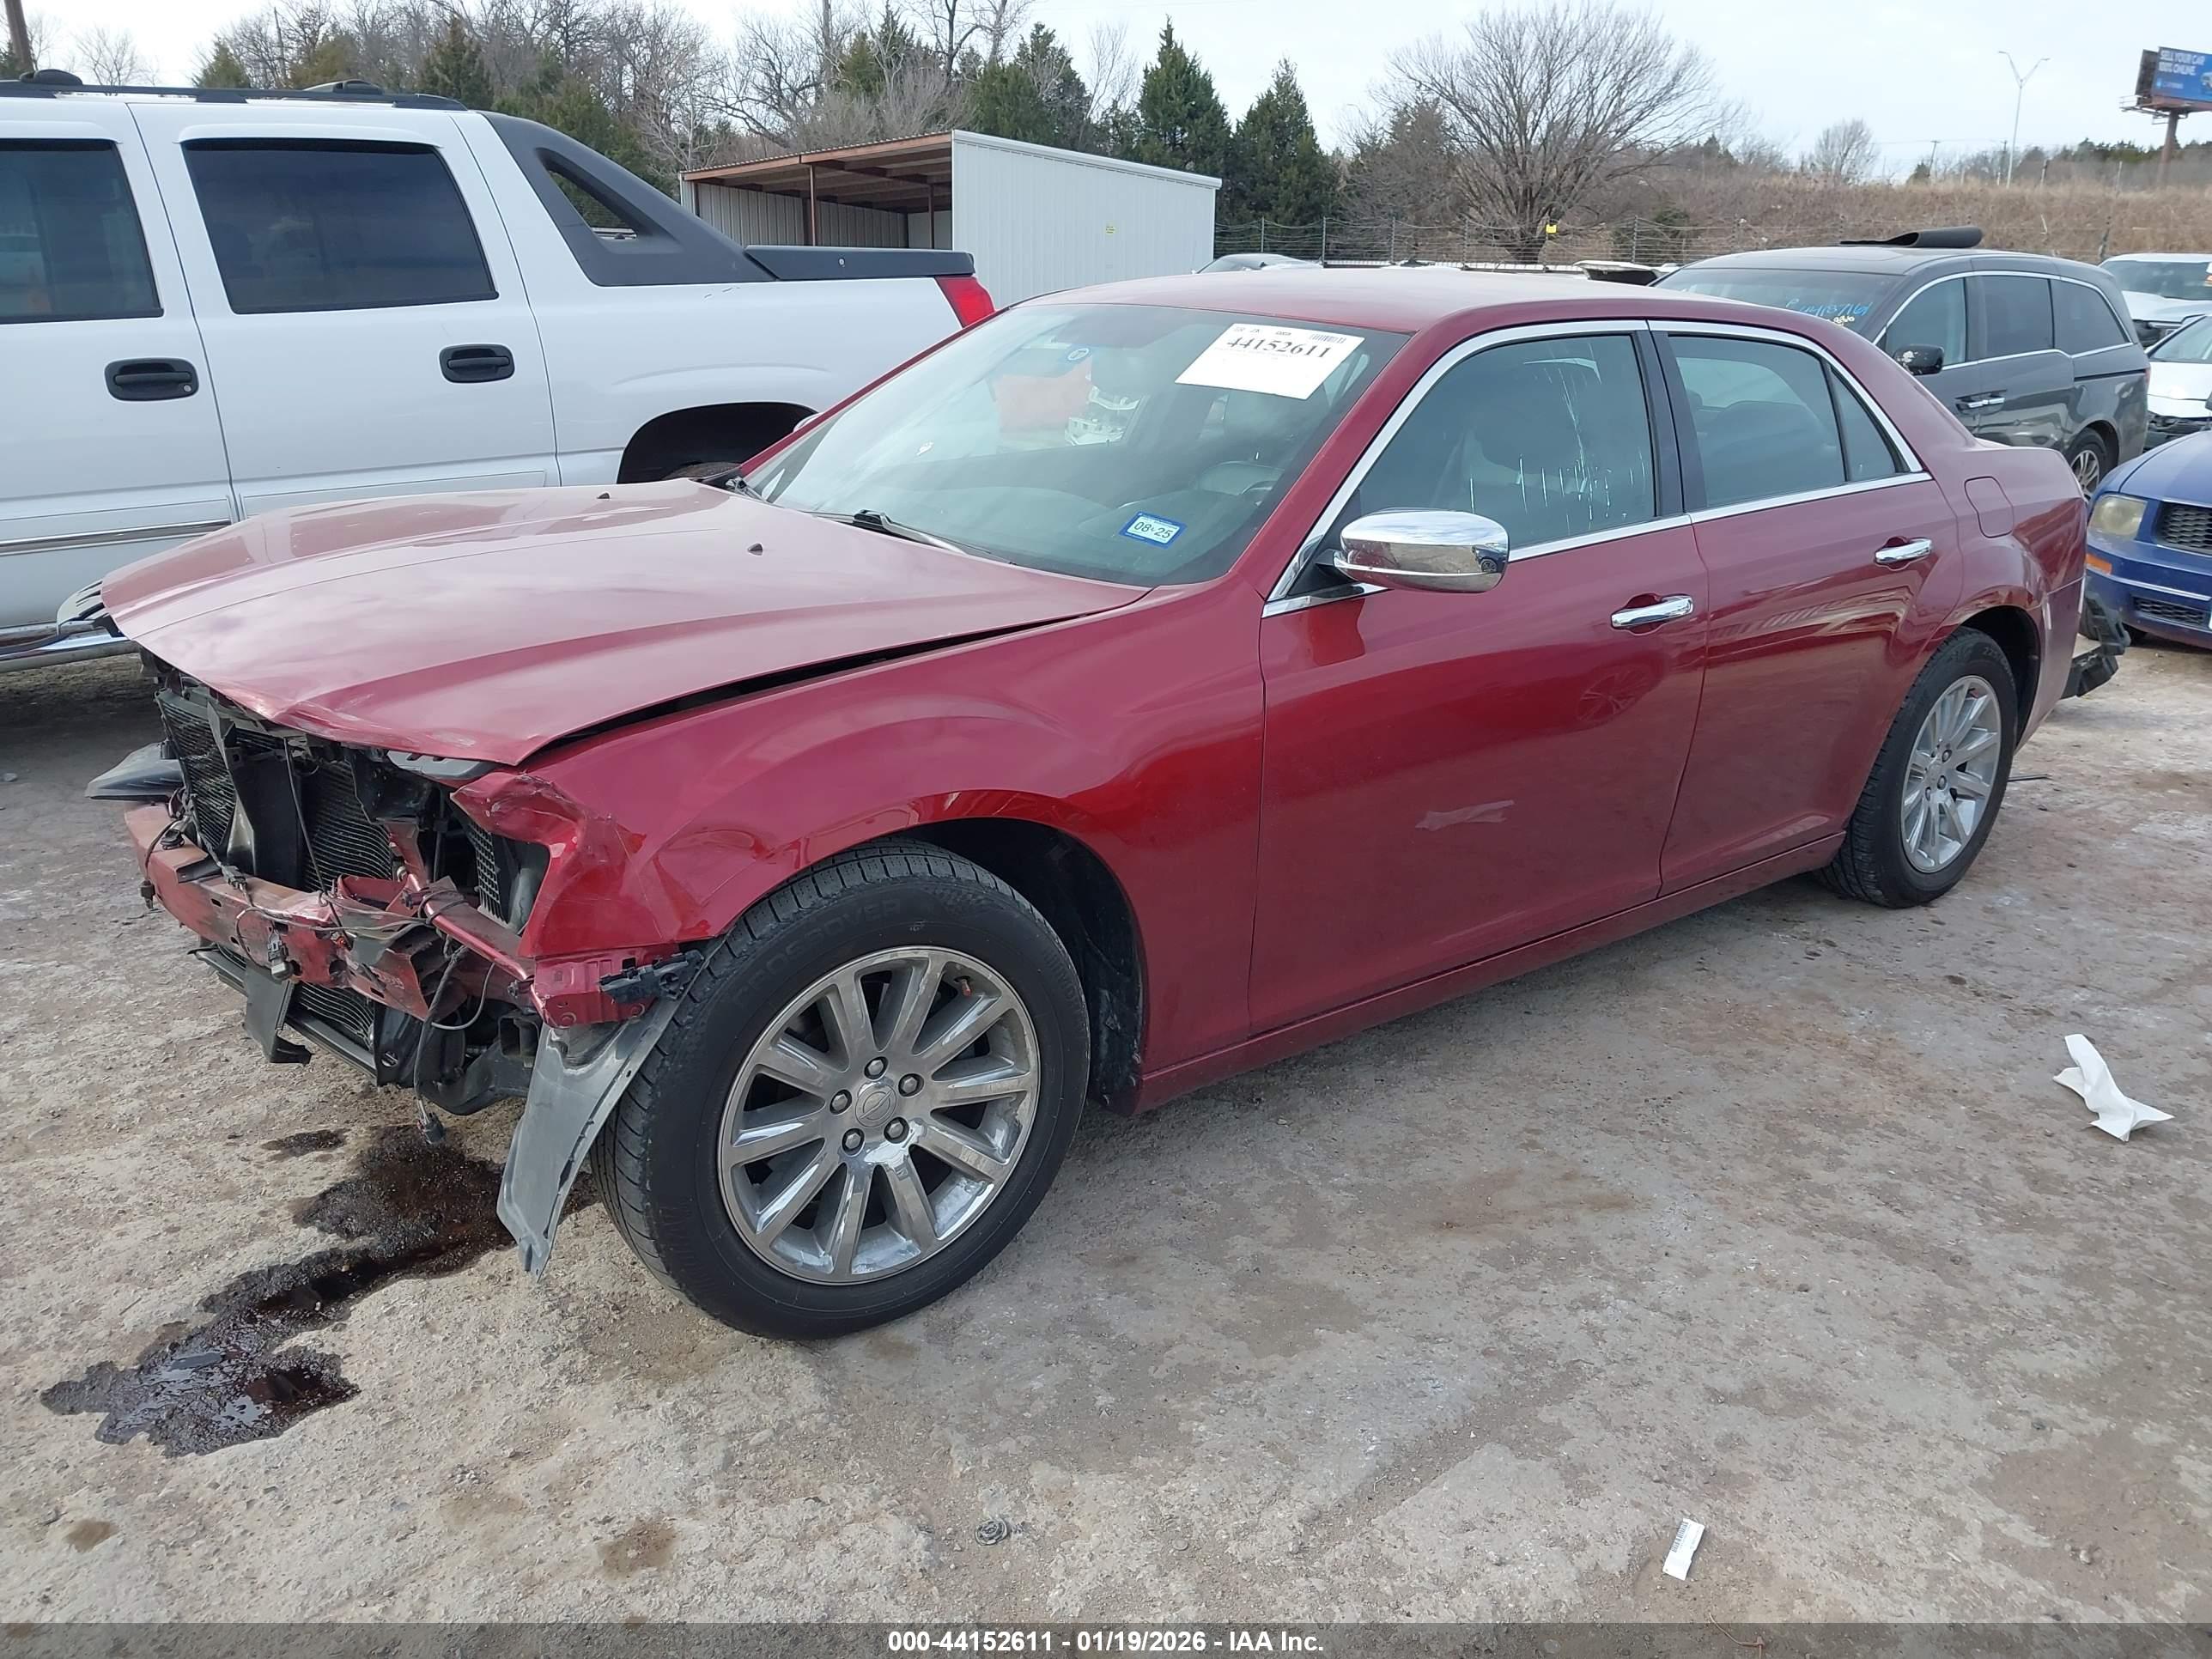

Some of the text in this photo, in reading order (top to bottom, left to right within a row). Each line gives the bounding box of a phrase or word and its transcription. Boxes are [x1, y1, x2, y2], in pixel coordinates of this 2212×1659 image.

[1227, 336, 1332, 358] 44152611
[1133, 521, 1152, 532] 08
[1154, 527, 1174, 538] 25
